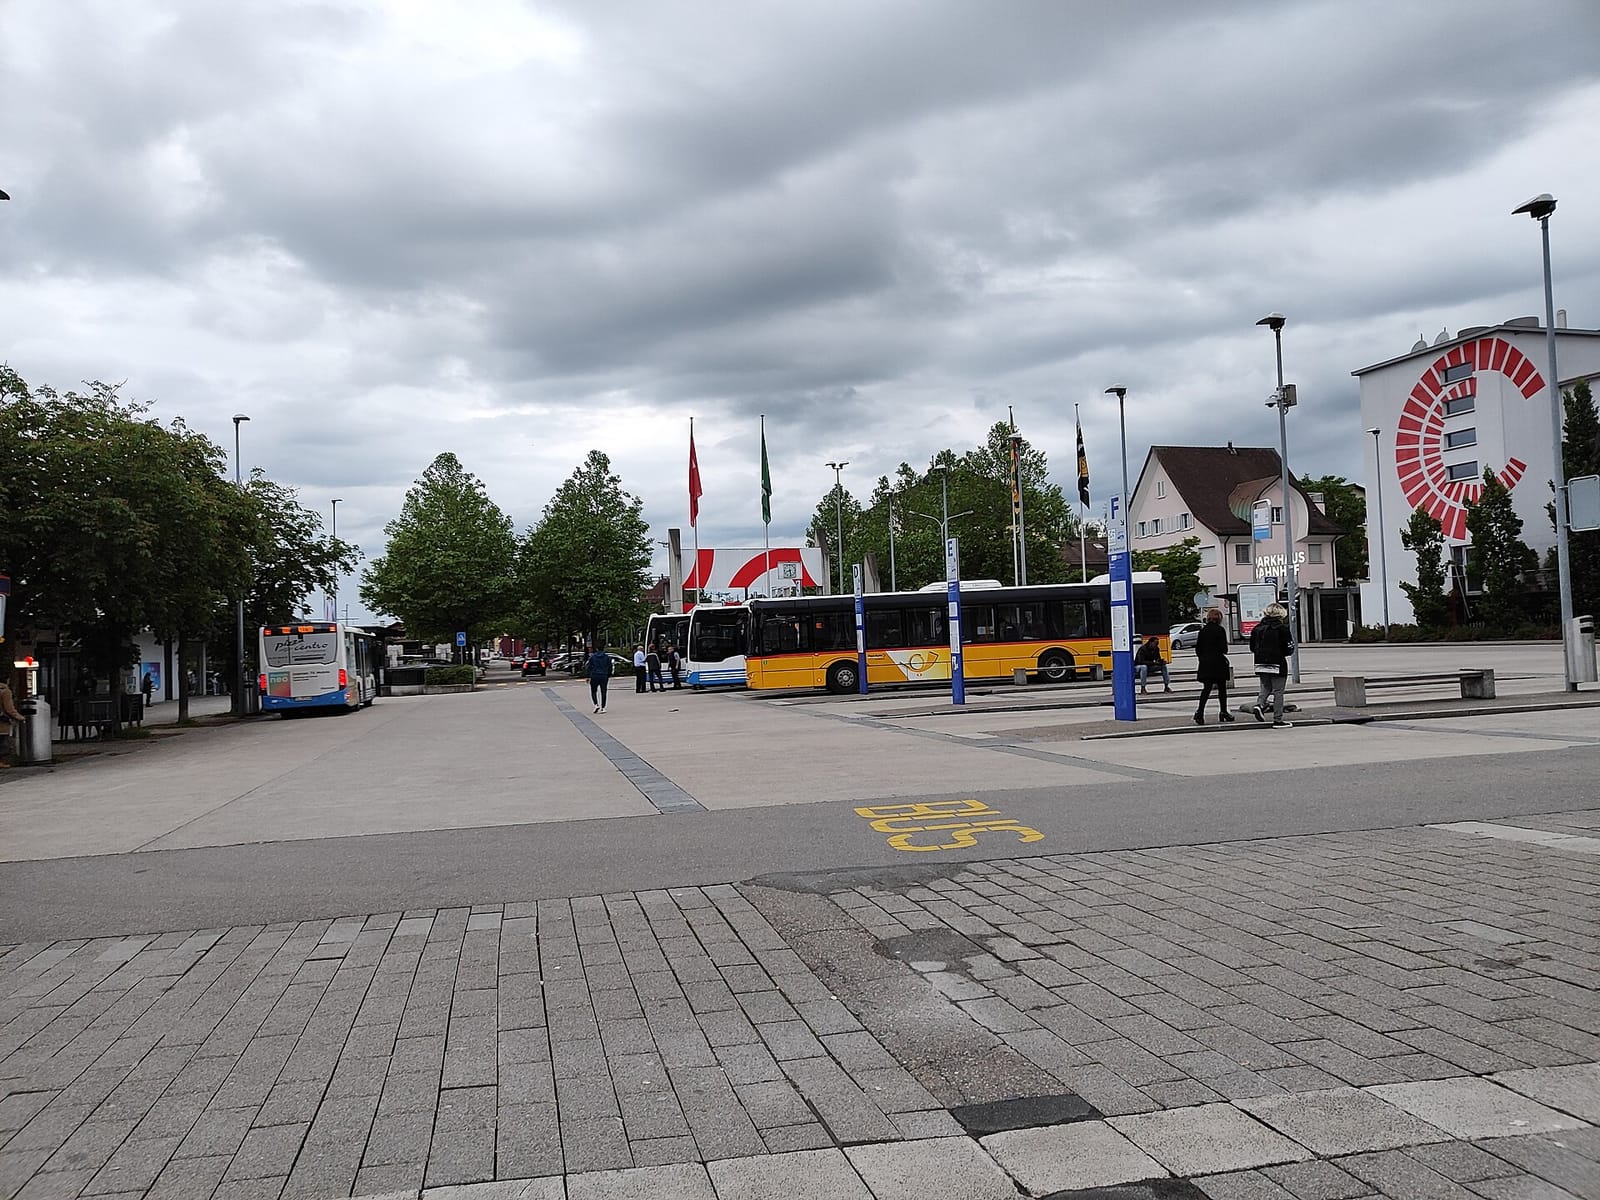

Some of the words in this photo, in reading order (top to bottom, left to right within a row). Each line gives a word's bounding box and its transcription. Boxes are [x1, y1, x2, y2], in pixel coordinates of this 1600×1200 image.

[1111, 497, 1119, 519] F
[948, 541, 953, 557] E
[1255, 551, 1306, 569] ARKHUS
[854, 566, 859, 578] D
[854, 799, 1046, 852] BUS
